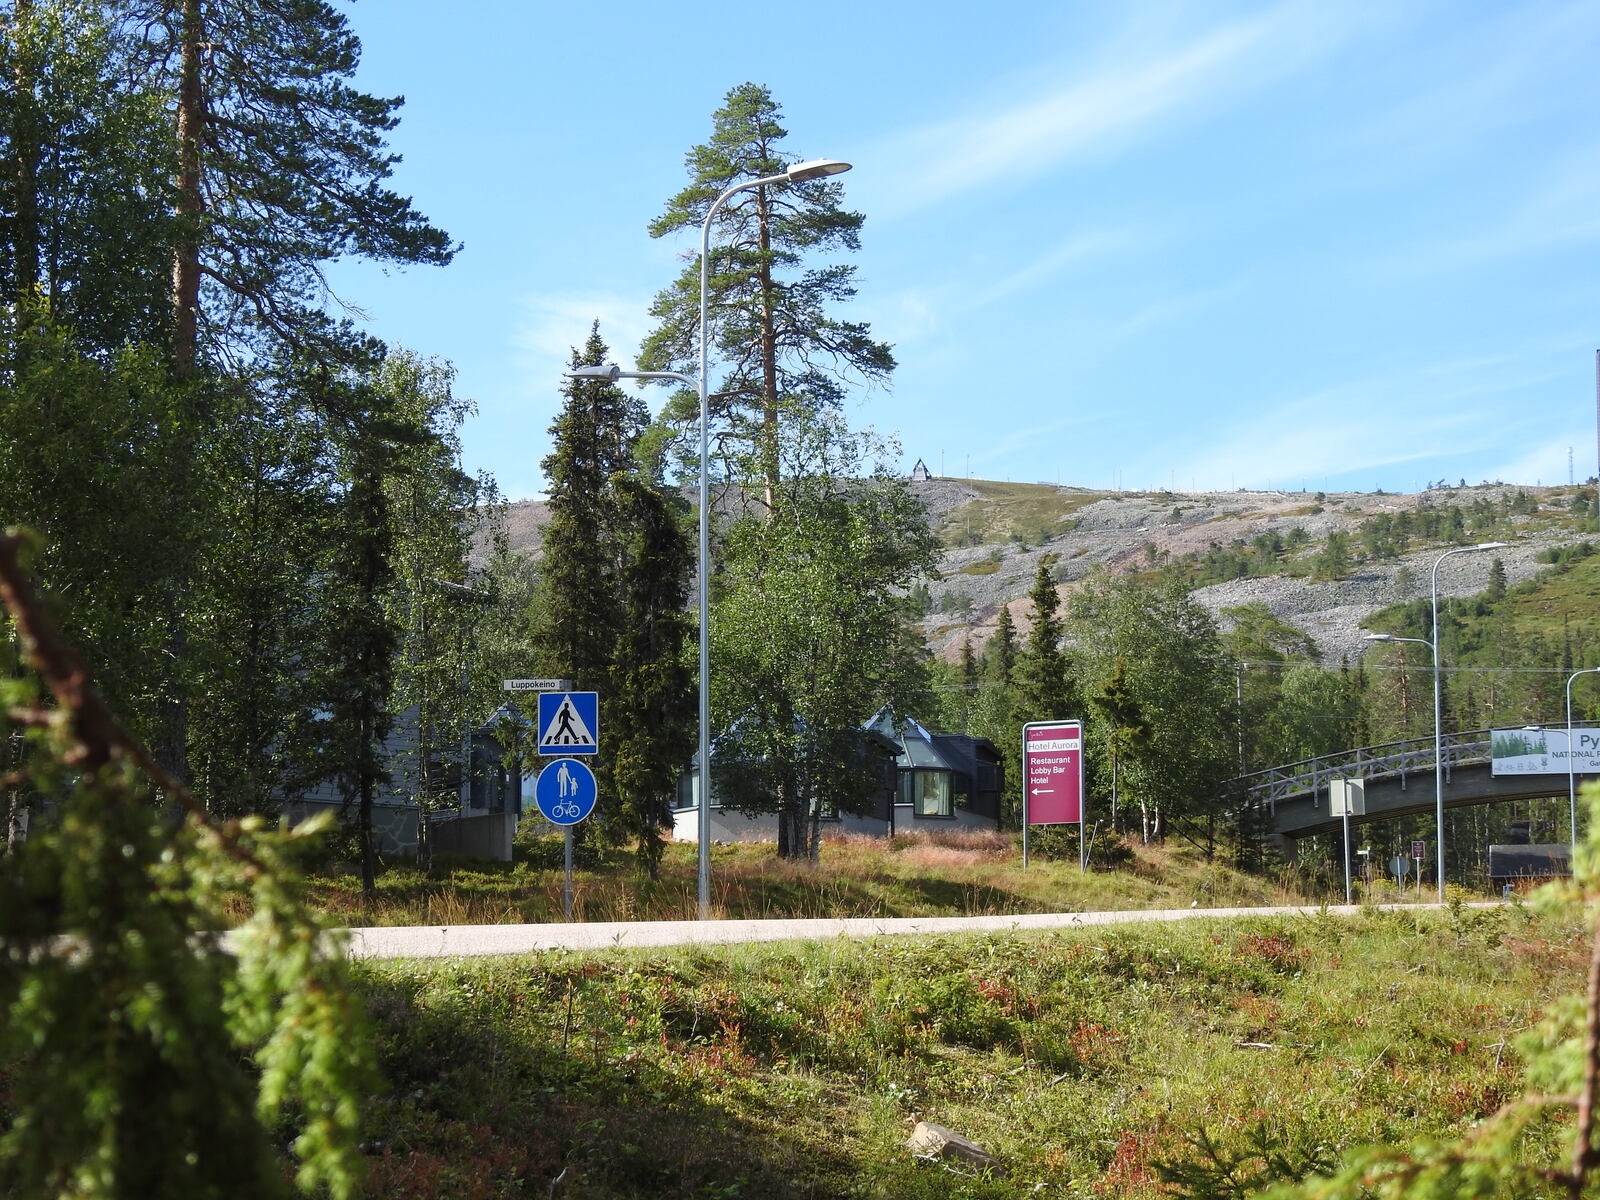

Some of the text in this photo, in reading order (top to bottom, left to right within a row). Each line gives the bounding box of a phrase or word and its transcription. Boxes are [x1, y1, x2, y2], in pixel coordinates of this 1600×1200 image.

[511, 681, 555, 689] Luppokeino
[1029, 742, 1050, 750] Hotel
[1031, 756, 1070, 764] Restaurant
[1031, 767, 1051, 775] Lobby
